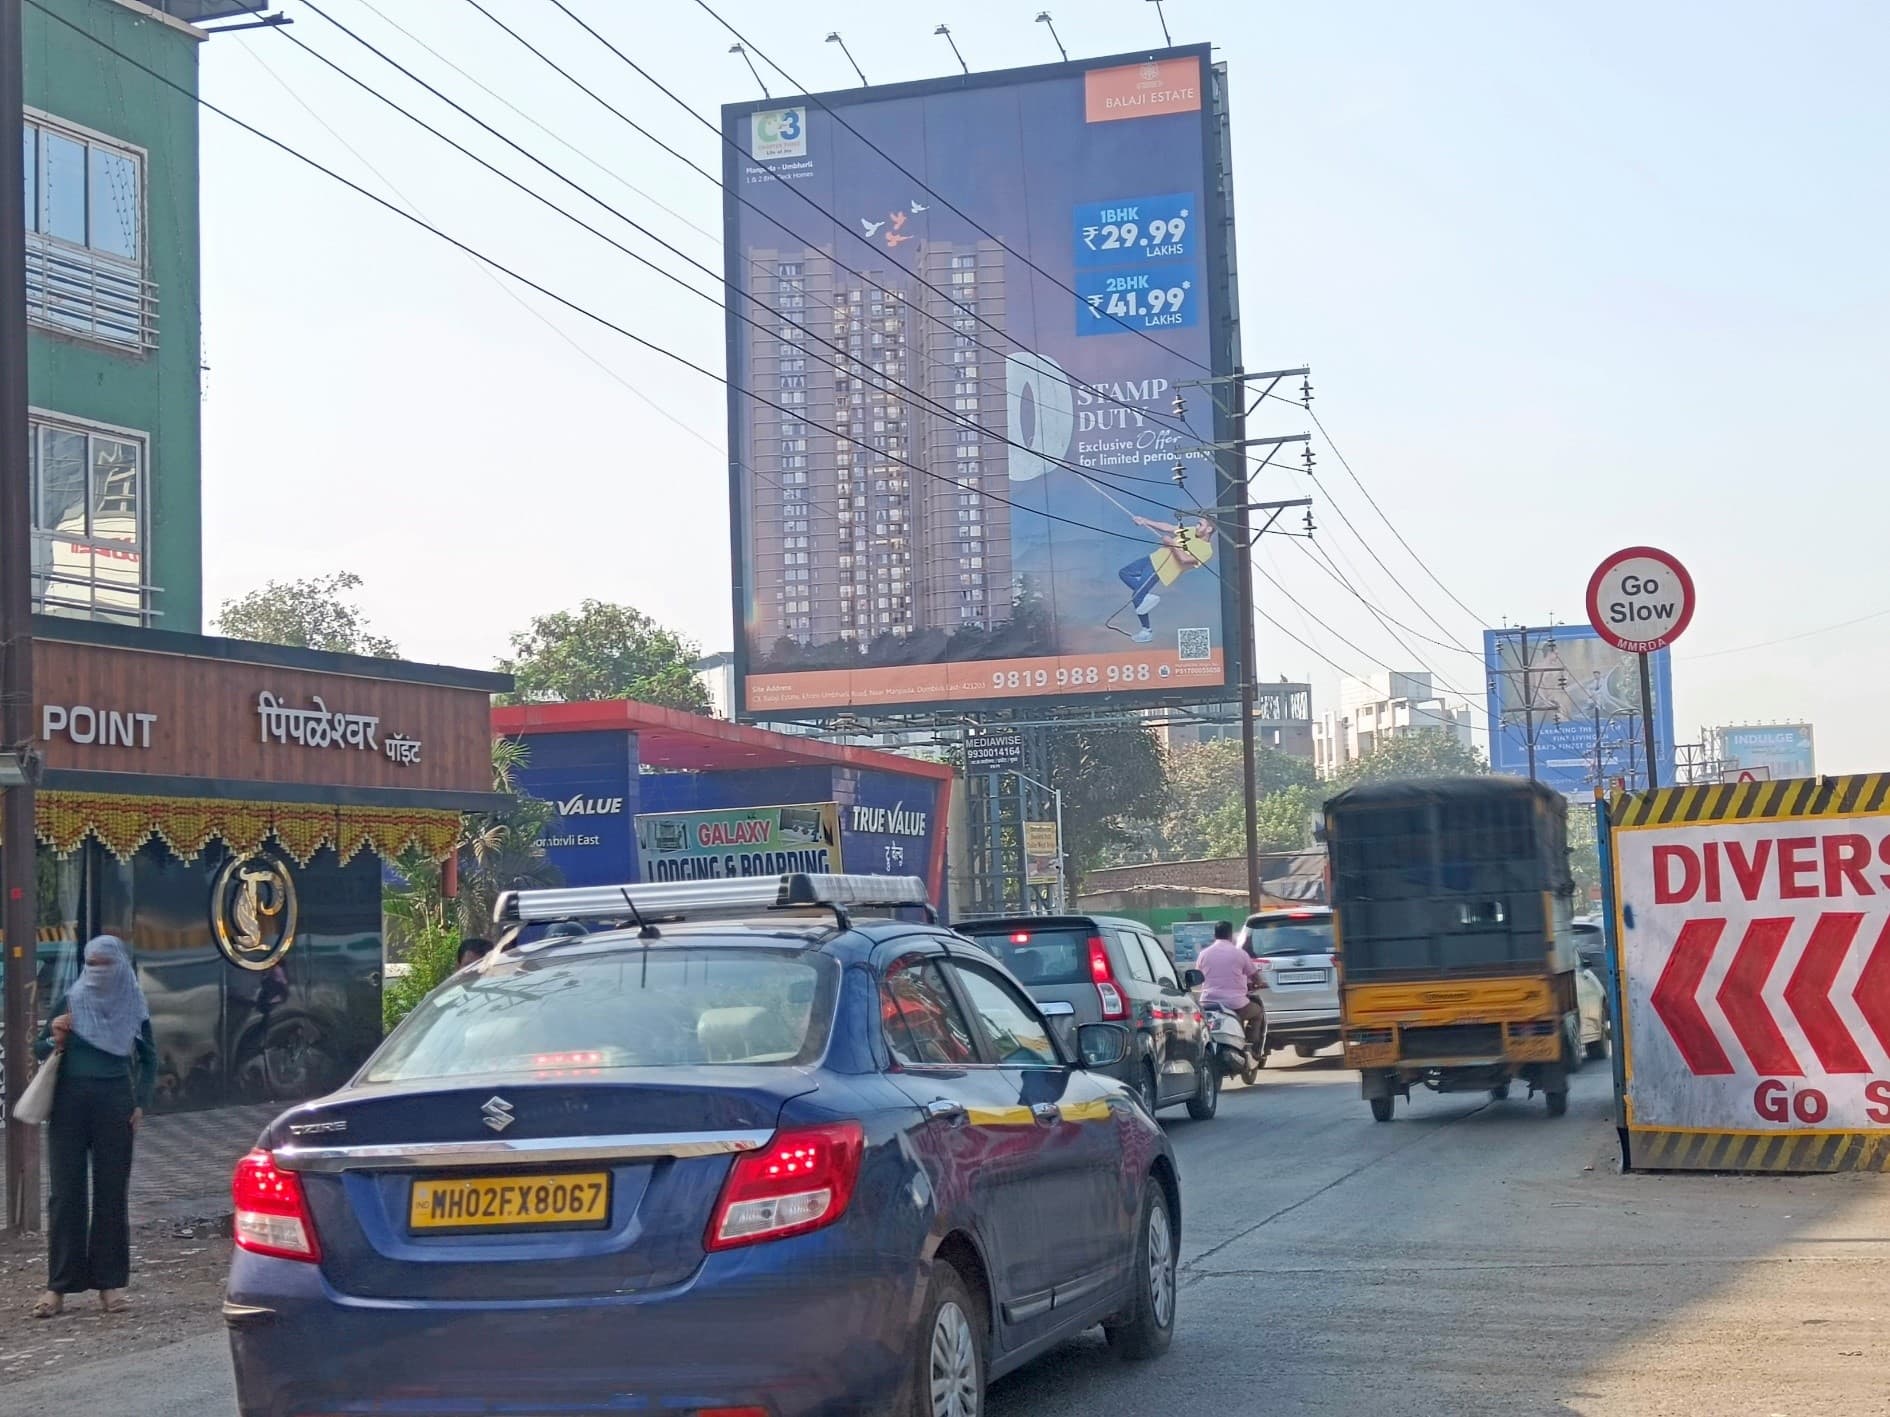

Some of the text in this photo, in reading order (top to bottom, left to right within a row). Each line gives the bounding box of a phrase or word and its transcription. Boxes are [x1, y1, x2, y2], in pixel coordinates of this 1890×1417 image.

[1105, 88, 1194, 108] BALAJI ESTATE
[746, 166, 776, 175] Manpda
[1100, 207, 1139, 223] 1BHK
[1146, 244, 1184, 257] LAKHS
[1106, 275, 1149, 292] 2BHK
[1145, 313, 1183, 327] LAKHS
[1077, 378, 1168, 406] STAMP
[1079, 407, 1149, 432] DUTY
[1079, 429, 1182, 453] Exclusive Offer
[1079, 455, 1096, 466] for
[1100, 451, 1140, 466] limited
[1621, 575, 1659, 596] Go
[1610, 601, 1675, 623] Slow
[1617, 638, 1667, 652] MMRDA
[992, 663, 1150, 689] 9819 988 988
[766, 684, 792, 692] Address
[42, 704, 158, 748] POINT
[257, 690, 422, 766] पिंपळेश्वर पॉइंट
[965, 735, 1023, 748] MEDIAWISE
[1734, 733, 1794, 745] INDULGE
[556, 793, 623, 816] VALUE
[853, 800, 926, 837] TRUE VALUE
[533, 834, 600, 847] ombivli East
[698, 820, 772, 848] GALAXY
[725, 854, 737, 879] &
[1753, 1078, 1829, 1123] Go
[415, 1200, 430, 1209] IND
[431, 1182, 602, 1219] MH02FX8067
